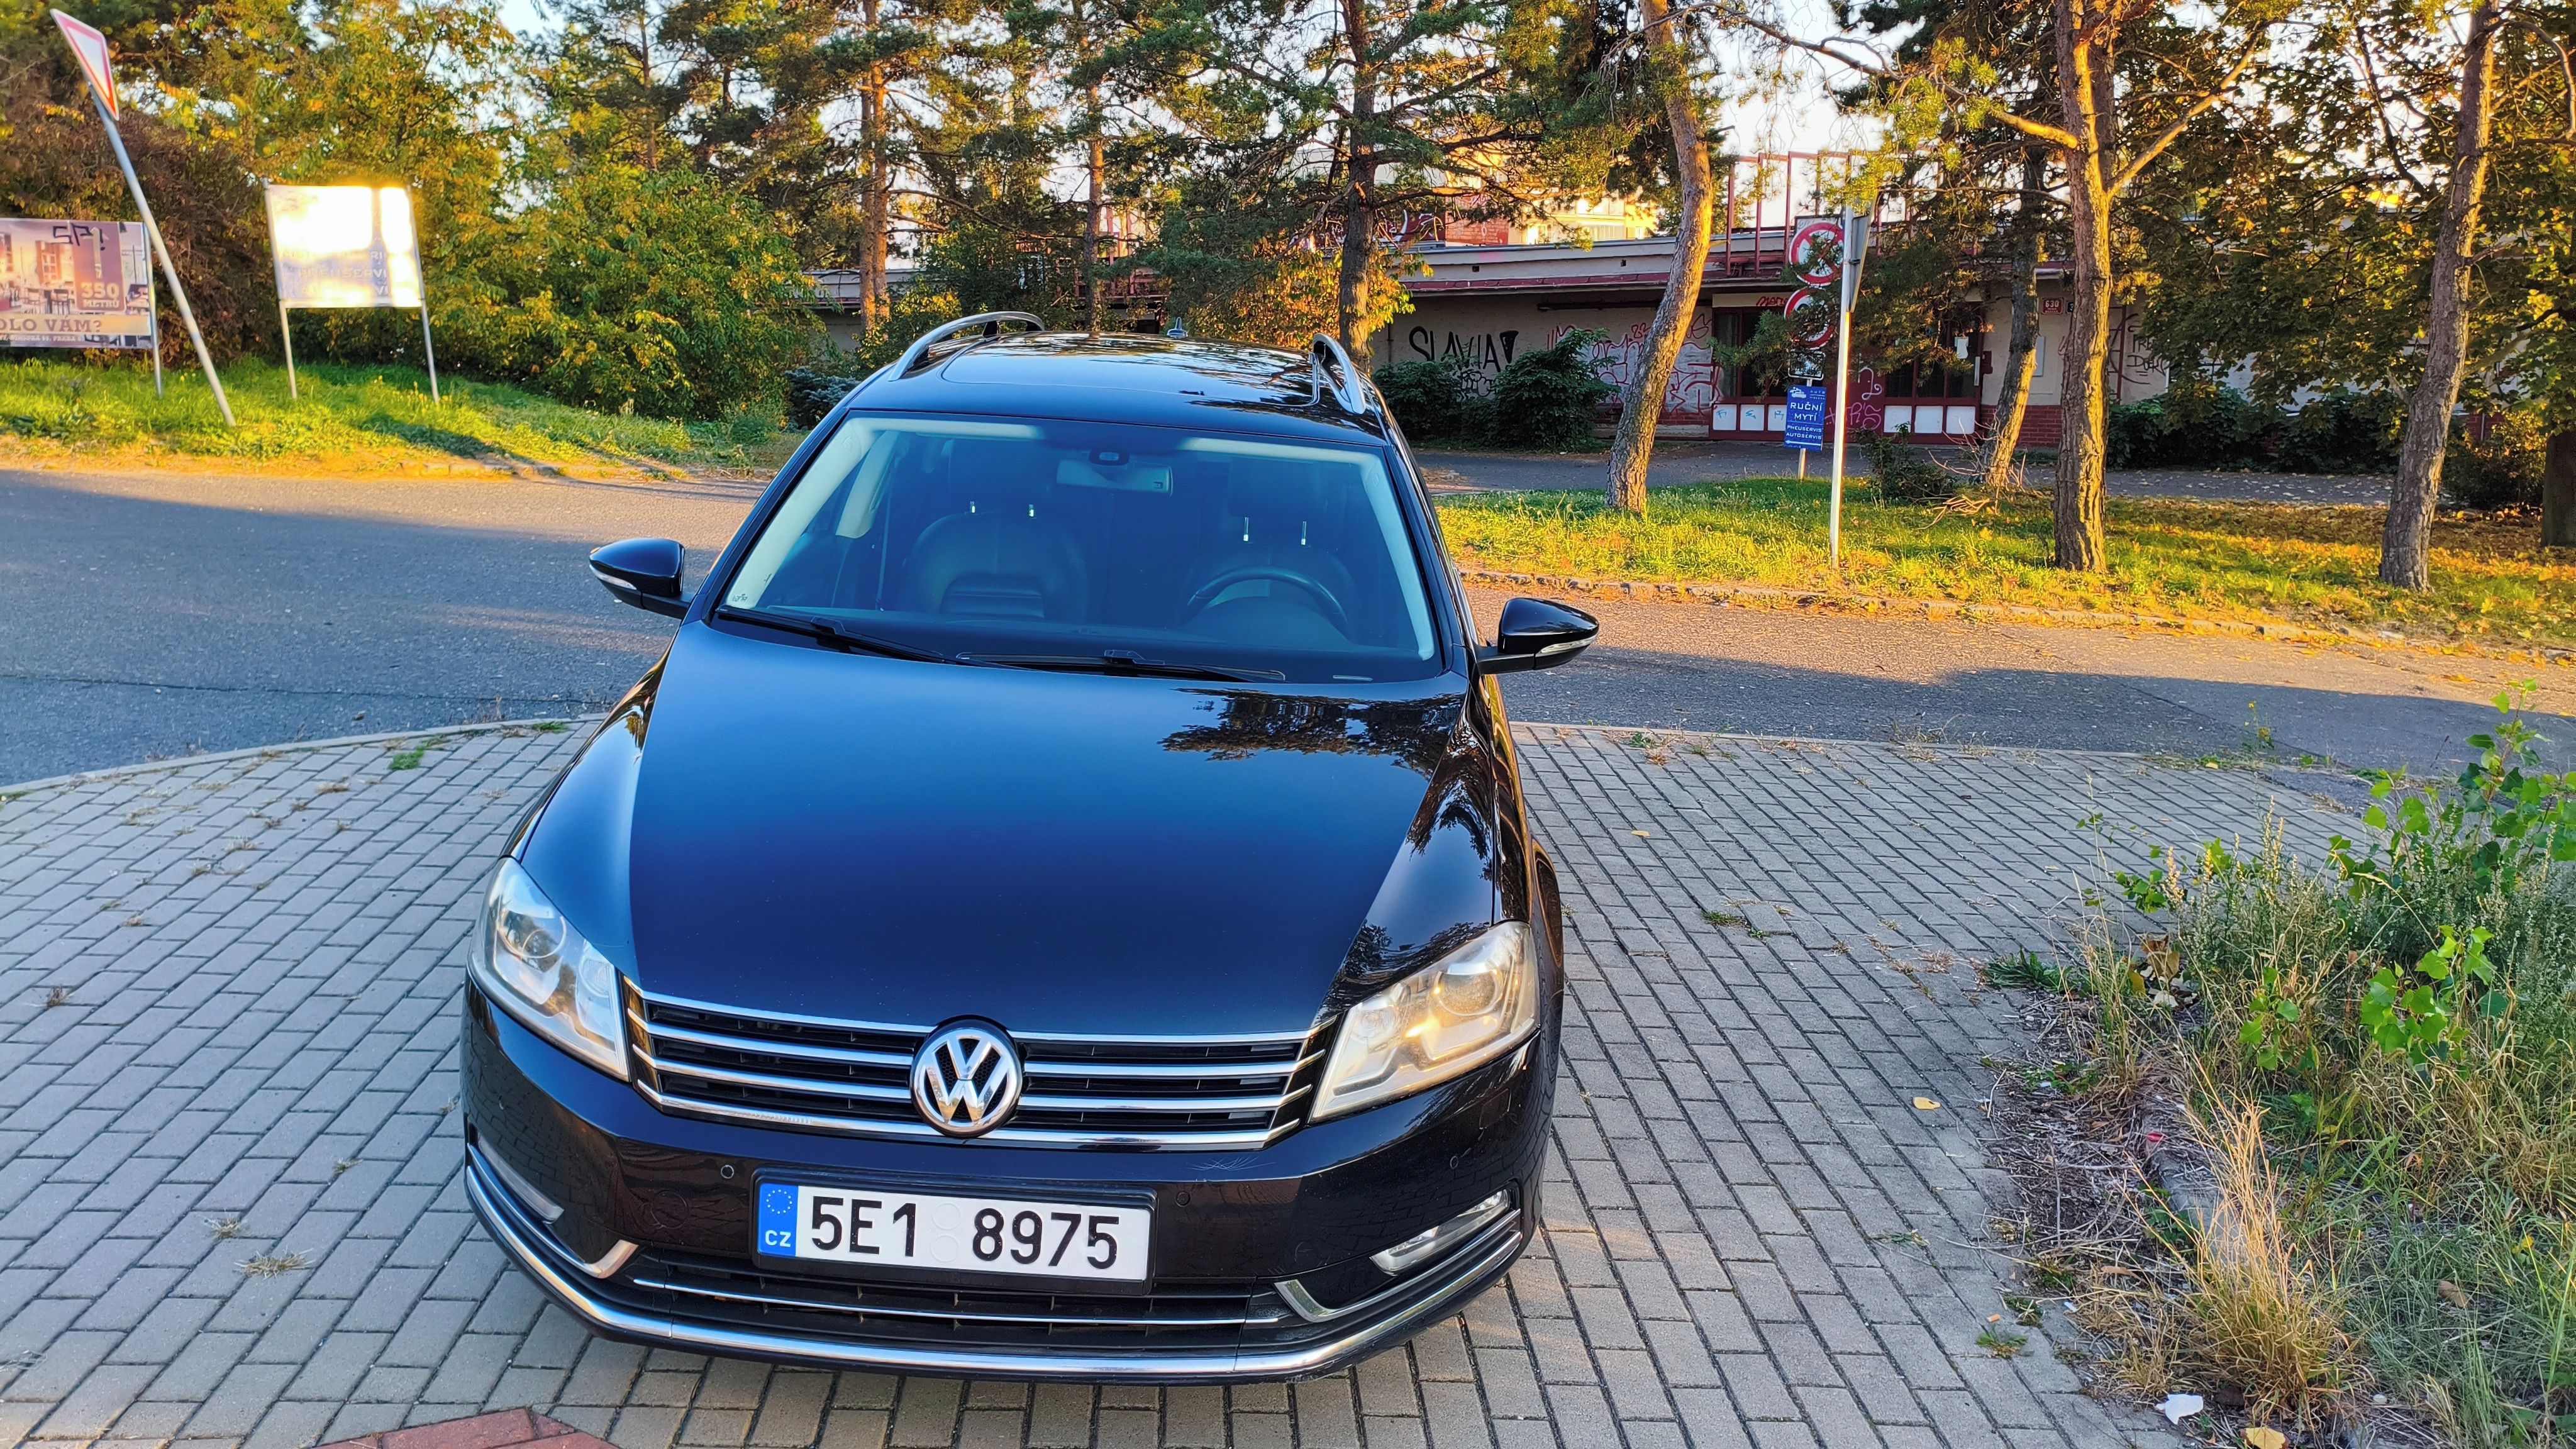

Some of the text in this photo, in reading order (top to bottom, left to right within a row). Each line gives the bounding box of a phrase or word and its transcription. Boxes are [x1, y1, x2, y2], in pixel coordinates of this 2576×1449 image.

[80, 282, 119, 299] 350
[45, 315, 103, 333] VÁM?
[1790, 401, 1823, 411] RUČNÍ
[1794, 413, 1818, 421] MYTÍ
[1787, 425, 1823, 433] PNEUSERVIS
[765, 1229, 792, 1248] CZ
[811, 1195, 1120, 1270] 5E1 8975
